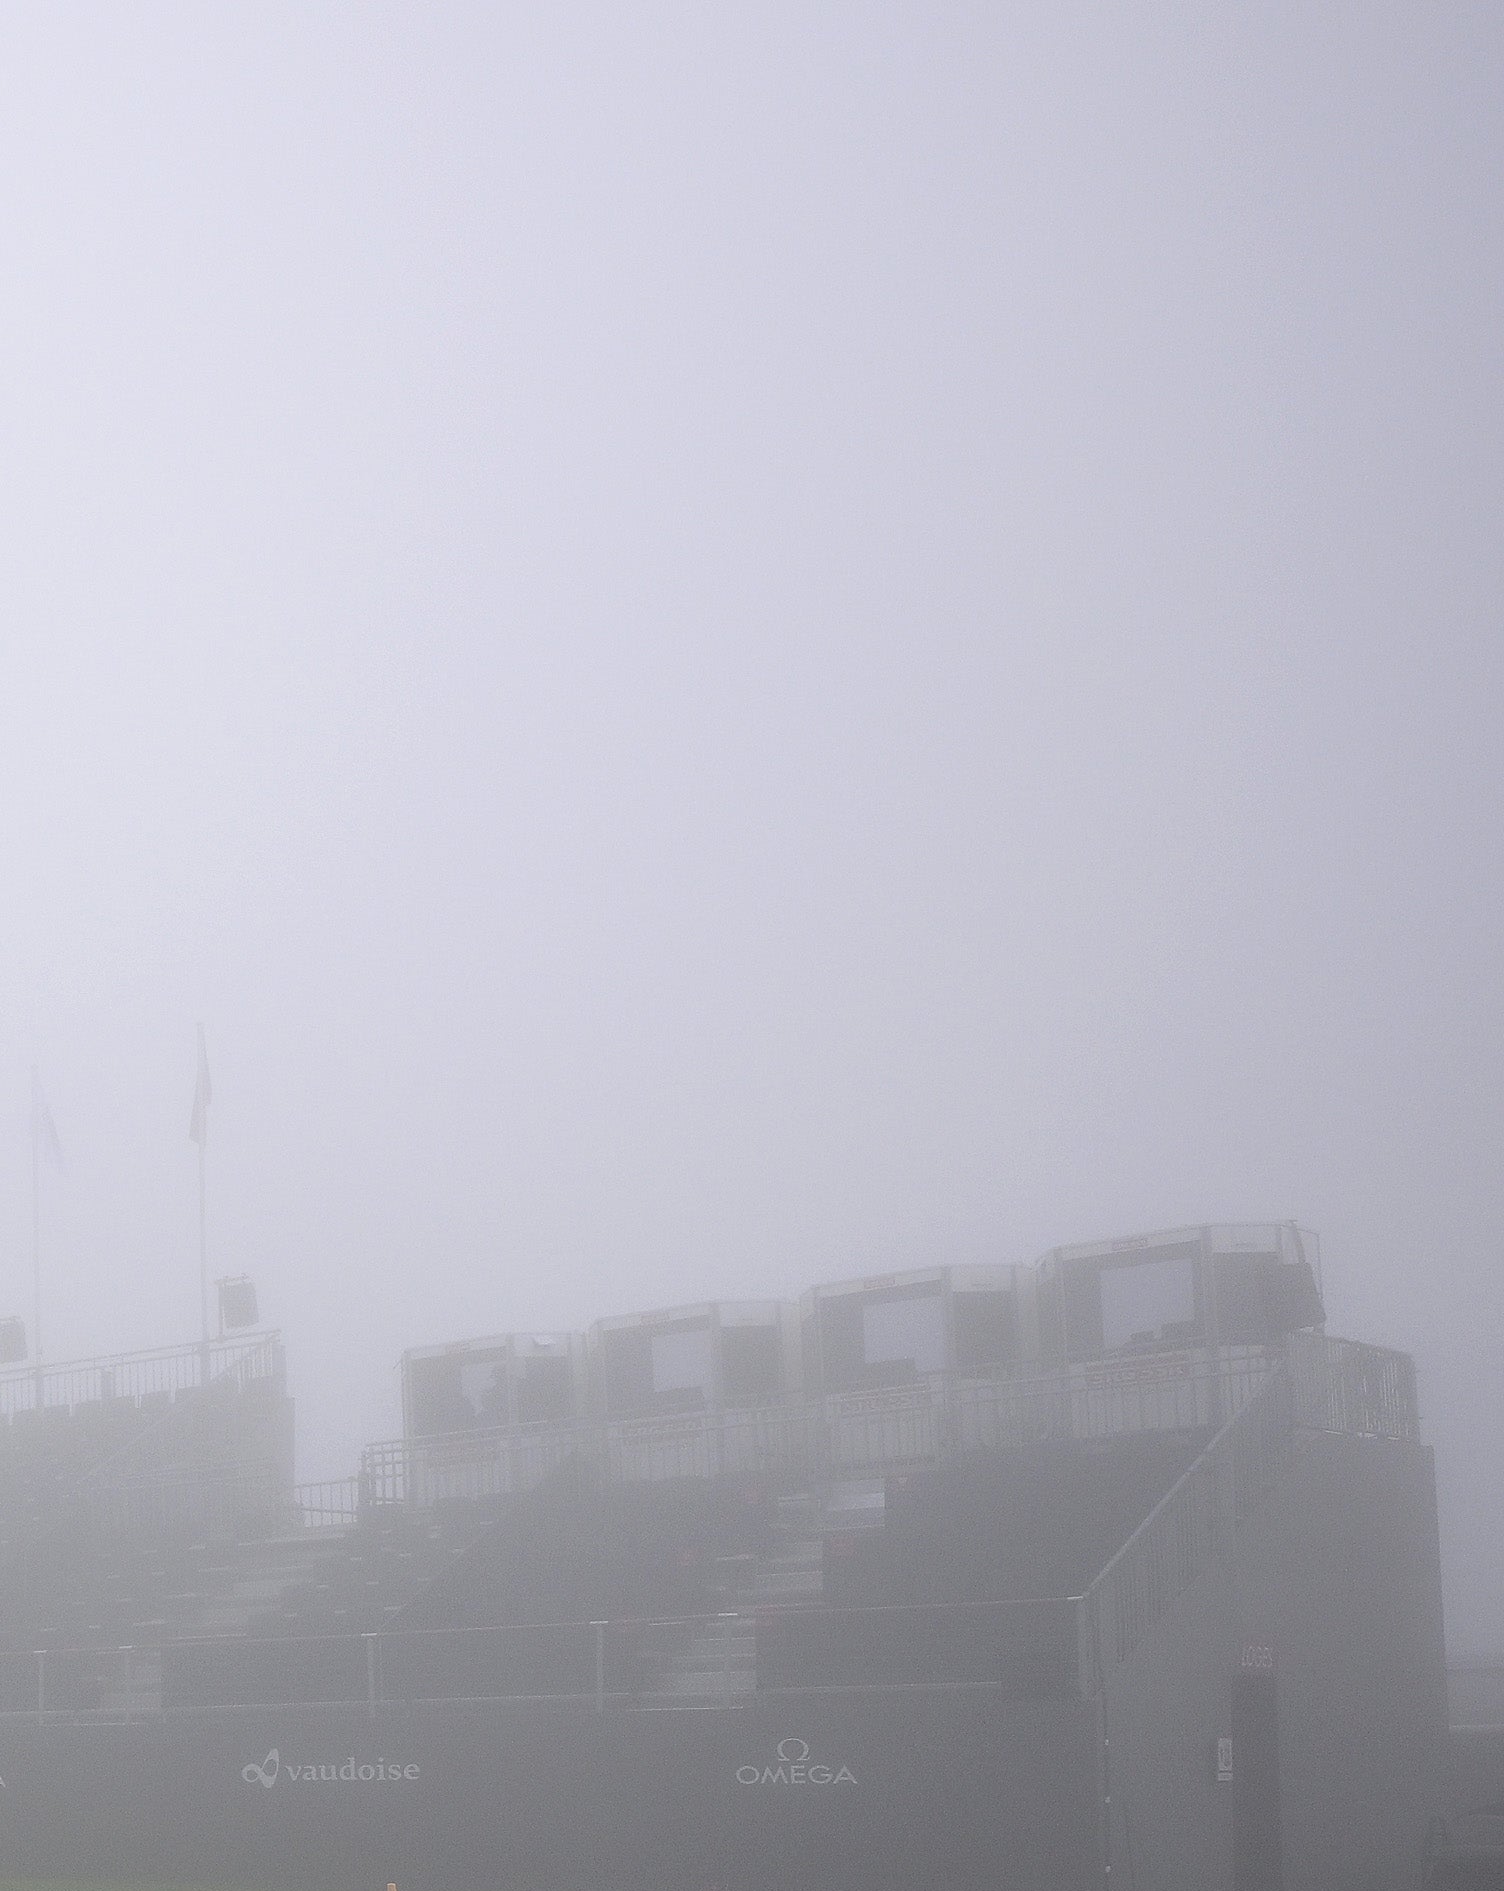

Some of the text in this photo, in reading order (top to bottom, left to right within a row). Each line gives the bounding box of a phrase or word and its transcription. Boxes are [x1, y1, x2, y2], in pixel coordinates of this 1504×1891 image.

[1240, 1645, 1274, 1668] LOGES
[286, 1755, 421, 1782] vaudoise
[734, 1764, 859, 1785] OMEGA
